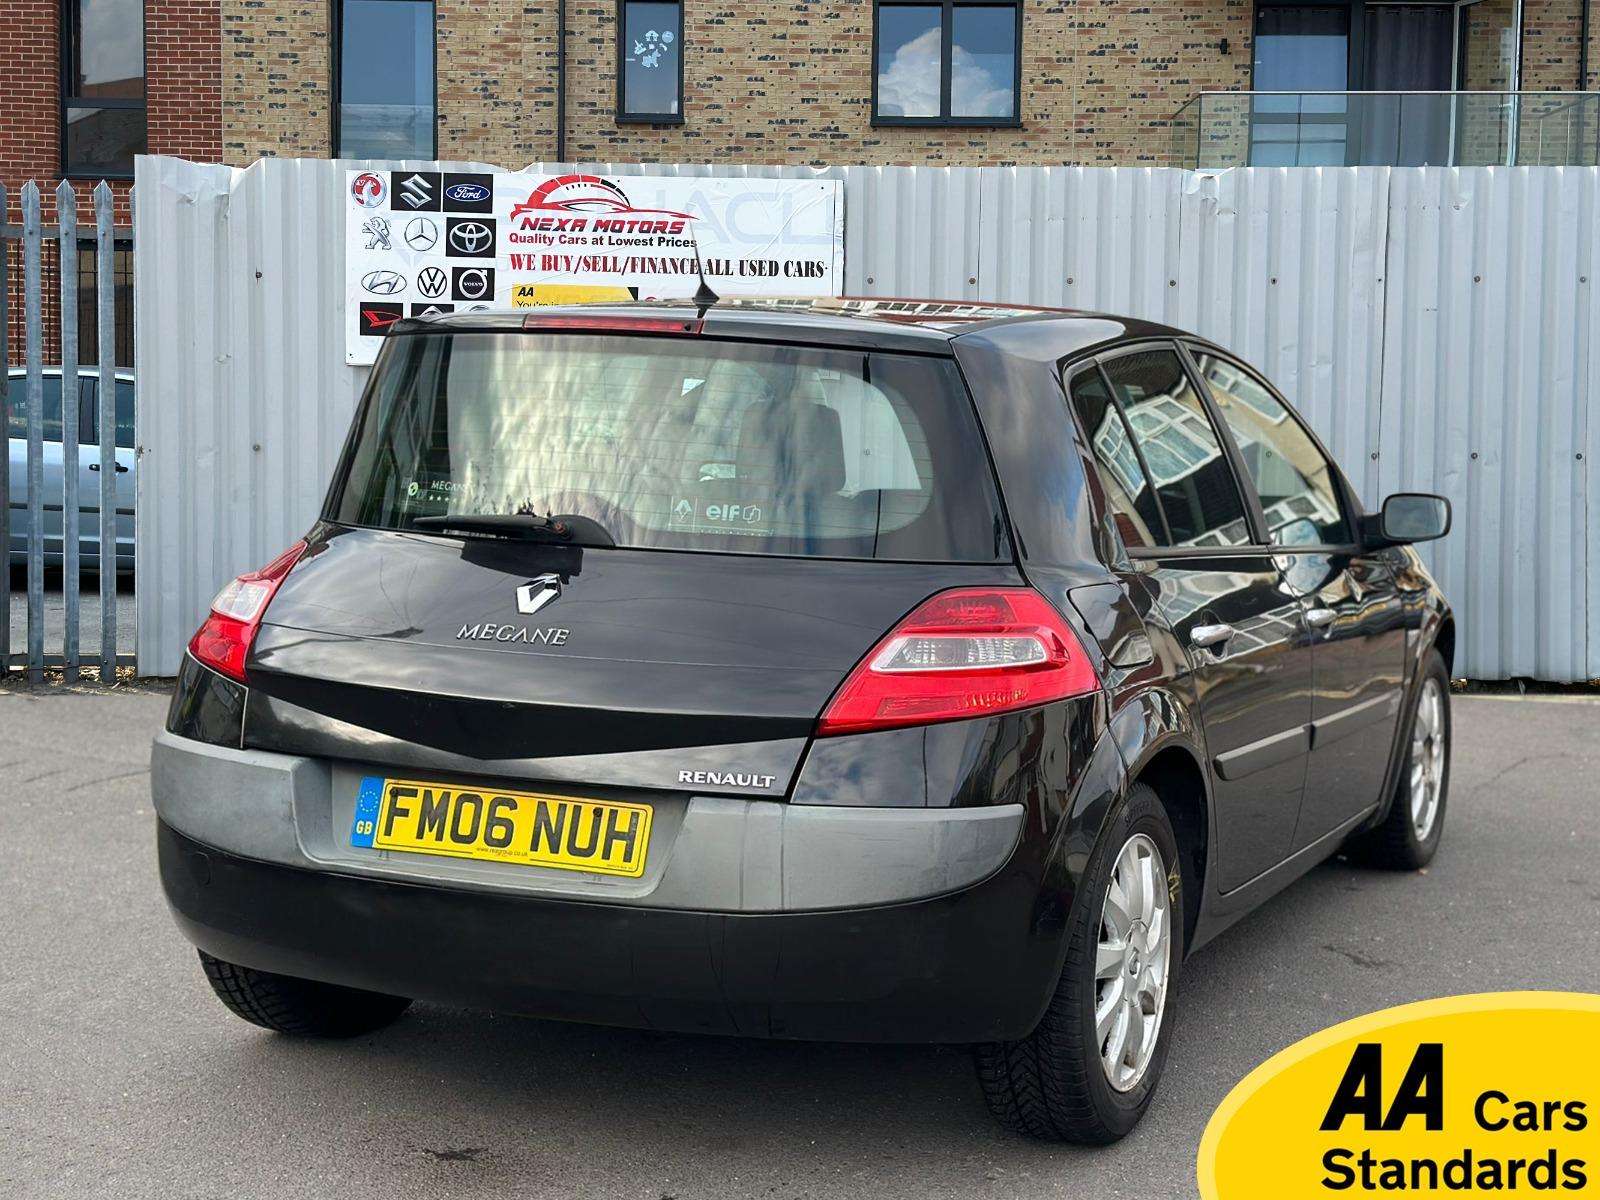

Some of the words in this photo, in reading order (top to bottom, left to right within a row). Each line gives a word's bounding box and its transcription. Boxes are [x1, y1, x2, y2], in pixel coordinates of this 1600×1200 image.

[454, 186, 481, 199] Ford
[520, 217, 587, 233] NEXA
[592, 219, 686, 235] MOTORS
[509, 233, 554, 247] Quality
[558, 234, 587, 245] Cars
[591, 235, 604, 246] at
[608, 235, 653, 247] Lowest
[657, 236, 697, 248] Prices
[509, 253, 536, 271] WE
[704, 258, 733, 276] ALL
[738, 259, 780, 277] USED
[783, 260, 825, 278] CARS
[517, 286, 535, 297] AA
[706, 504, 740, 521] elf
[456, 623, 570, 647] MEGANE
[678, 770, 776, 789] RENAULT
[356, 820, 373, 835] GB
[383, 786, 518, 848] FM06
[530, 800, 640, 863] NUH
